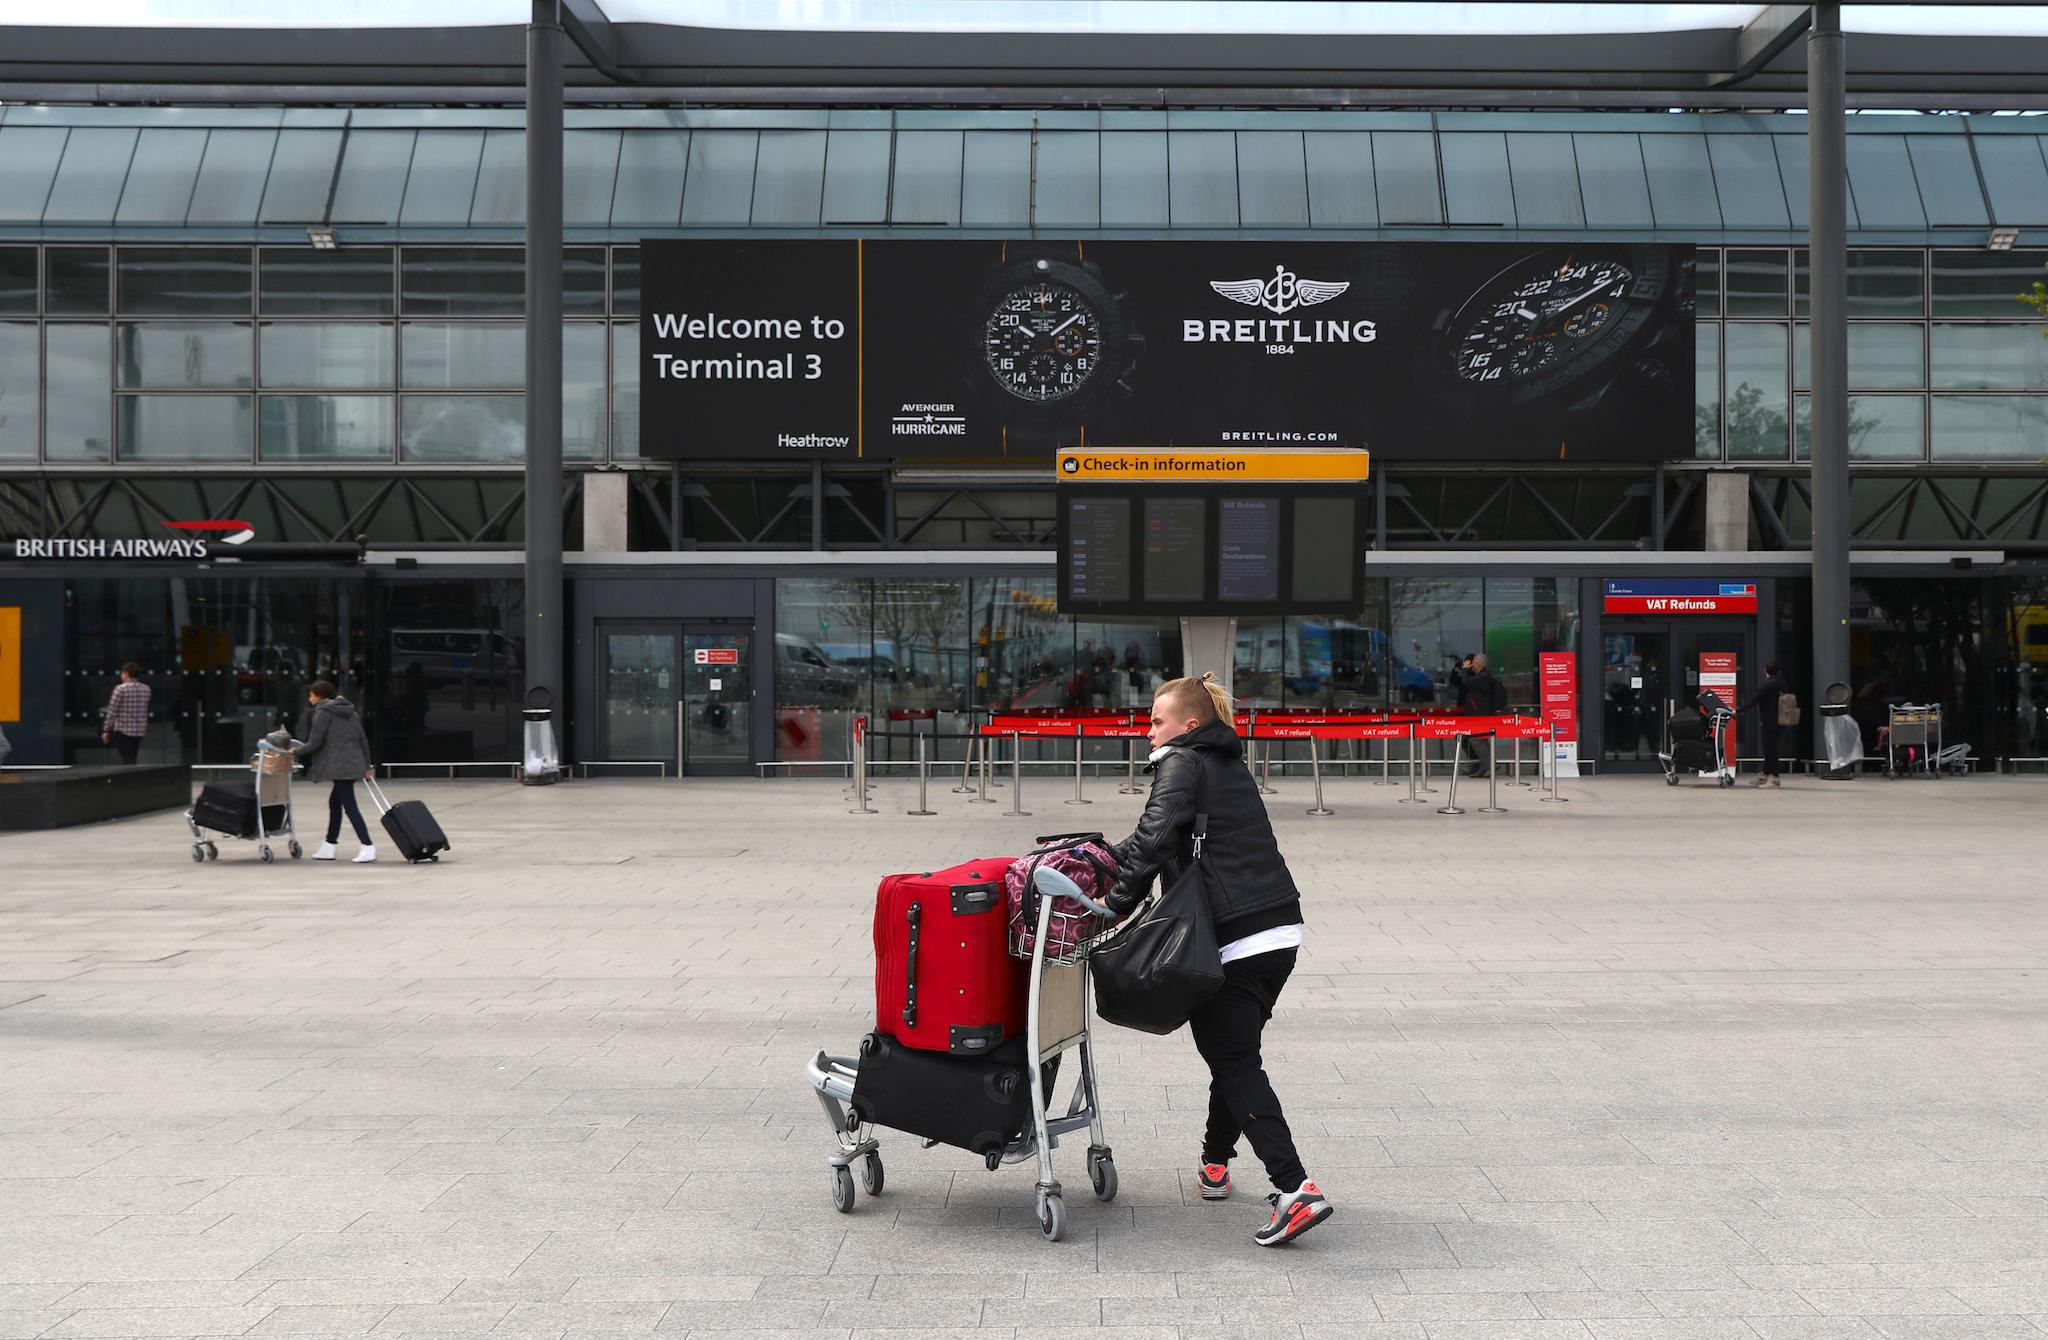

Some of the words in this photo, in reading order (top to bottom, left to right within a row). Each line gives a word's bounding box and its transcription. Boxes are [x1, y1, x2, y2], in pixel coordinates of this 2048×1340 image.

[1521, 280, 1552, 297] 22
[1609, 284, 1625, 299] 4
[1034, 292, 1053, 303] 24
[1012, 300, 1031, 311] 22
[1061, 300, 1071, 311] 2
[1494, 300, 1527, 318] 20
[653, 313, 802, 339] Welcome
[811, 315, 845, 339] to
[1000, 315, 1019, 326] 20
[1078, 315, 1087, 326] 4
[1183, 320, 1377, 343] BREITLING
[1266, 345, 1295, 354] 1884
[1001, 359, 1013, 370] 16
[1078, 359, 1086, 370] 8
[1469, 353, 1492, 368] 16
[653, 353, 793, 379] Terminal
[805, 354, 822, 380] 3
[1013, 373, 1027, 384] 14
[1061, 373, 1073, 384] 10
[1479, 367, 1502, 381] 14
[901, 404, 954, 412] AVENGER
[892, 424, 966, 435] HURRICANE
[778, 433, 849, 448] Heathrow
[1222, 432, 1338, 441] BREITLING.COM
[1083, 458, 1149, 471] Check-in
[1154, 458, 1246, 471] information
[16, 539, 105, 557] BRITISH
[111, 539, 207, 557] AIRWAYS
[1646, 599, 1668, 610] VAT
[1670, 598, 1716, 610] Refunds
[1378, 728, 1400, 736] refund
